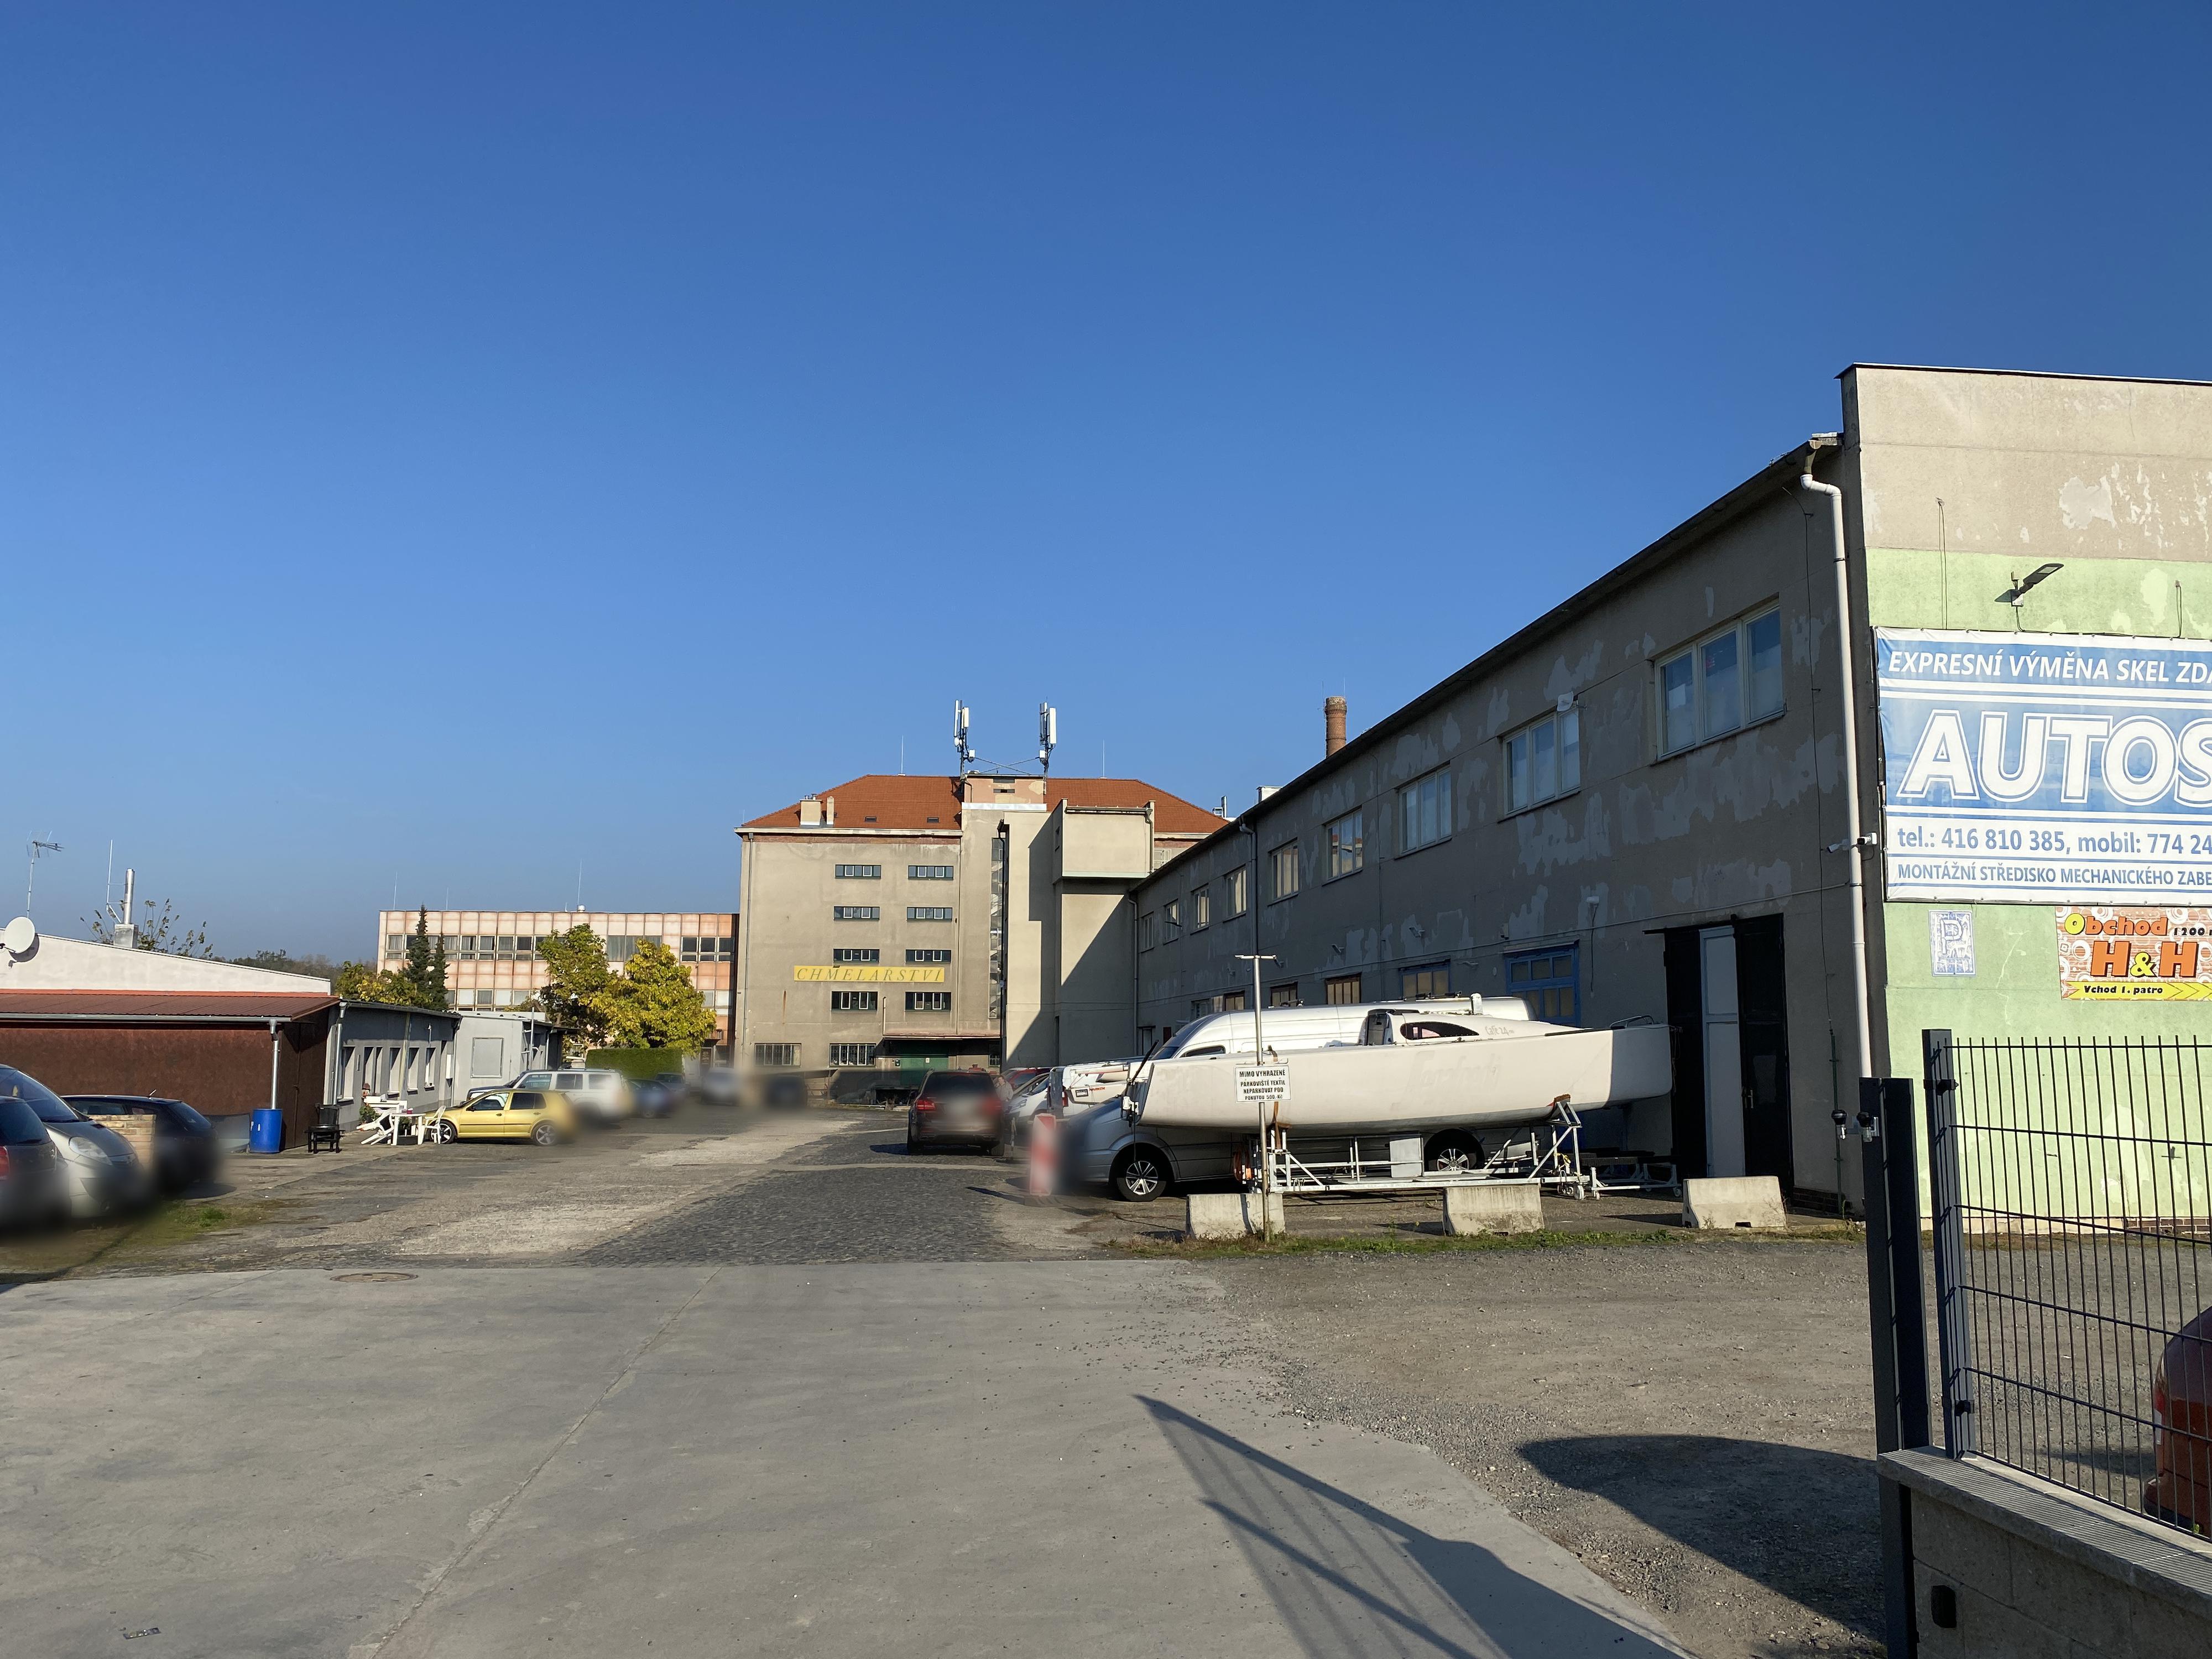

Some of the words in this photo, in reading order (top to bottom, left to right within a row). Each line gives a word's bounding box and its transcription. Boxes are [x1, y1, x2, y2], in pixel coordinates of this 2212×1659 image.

[1888, 649, 2004, 676] EXPRESNÍ
[2009, 650, 2109, 680] VÝMĚNA
[2116, 659, 2169, 682] SKEL
[1896, 709, 2212, 807] AUTOS
[1897, 826, 1935, 847] tel.:
[1941, 828, 1979, 849] 416
[1985, 829, 2022, 850] 810
[2029, 830, 2070, 855] 385,
[2078, 831, 2141, 853] mobil:
[2147, 833, 2184, 854] 774
[2190, 834, 2212, 855] 24
[1898, 861, 1976, 880] MONTÁŽNÍ
[1980, 863, 2056, 882] STŘEDISKO
[2060, 866, 2174, 885] MECHANICKÉHO
[2178, 871, 2212, 885] ZABE
[2064, 912, 2168, 936] Obchod
[797, 968, 942, 981] CHMELAŘSTVÍ
[2133, 987, 2163, 995] patro
